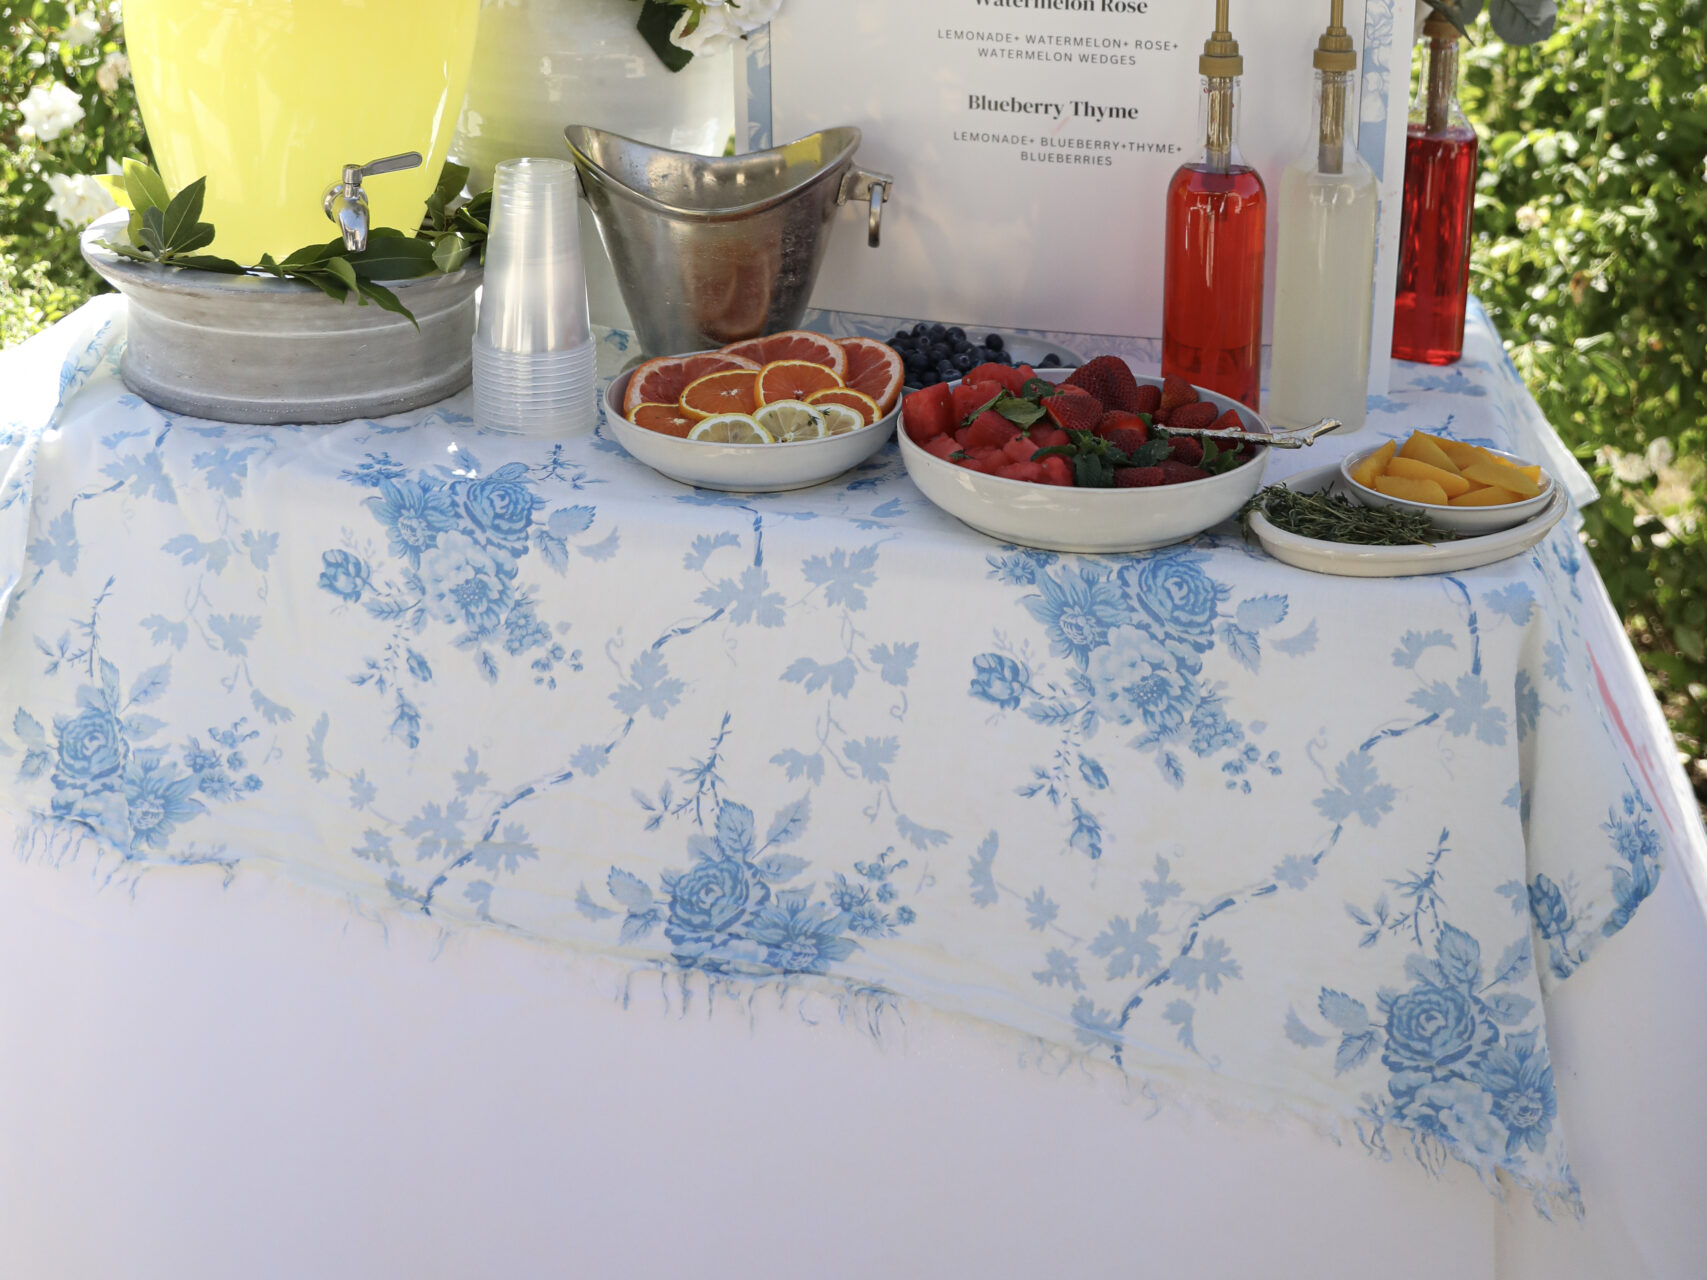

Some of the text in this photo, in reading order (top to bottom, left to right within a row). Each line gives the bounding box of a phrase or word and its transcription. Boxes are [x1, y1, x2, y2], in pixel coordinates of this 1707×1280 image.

[978, 48, 1136, 65] WATERMELON WEDGES
[968, 94, 1139, 123] Blueberry Thyme
[1020, 151, 1112, 166] BLUEBERRIES
